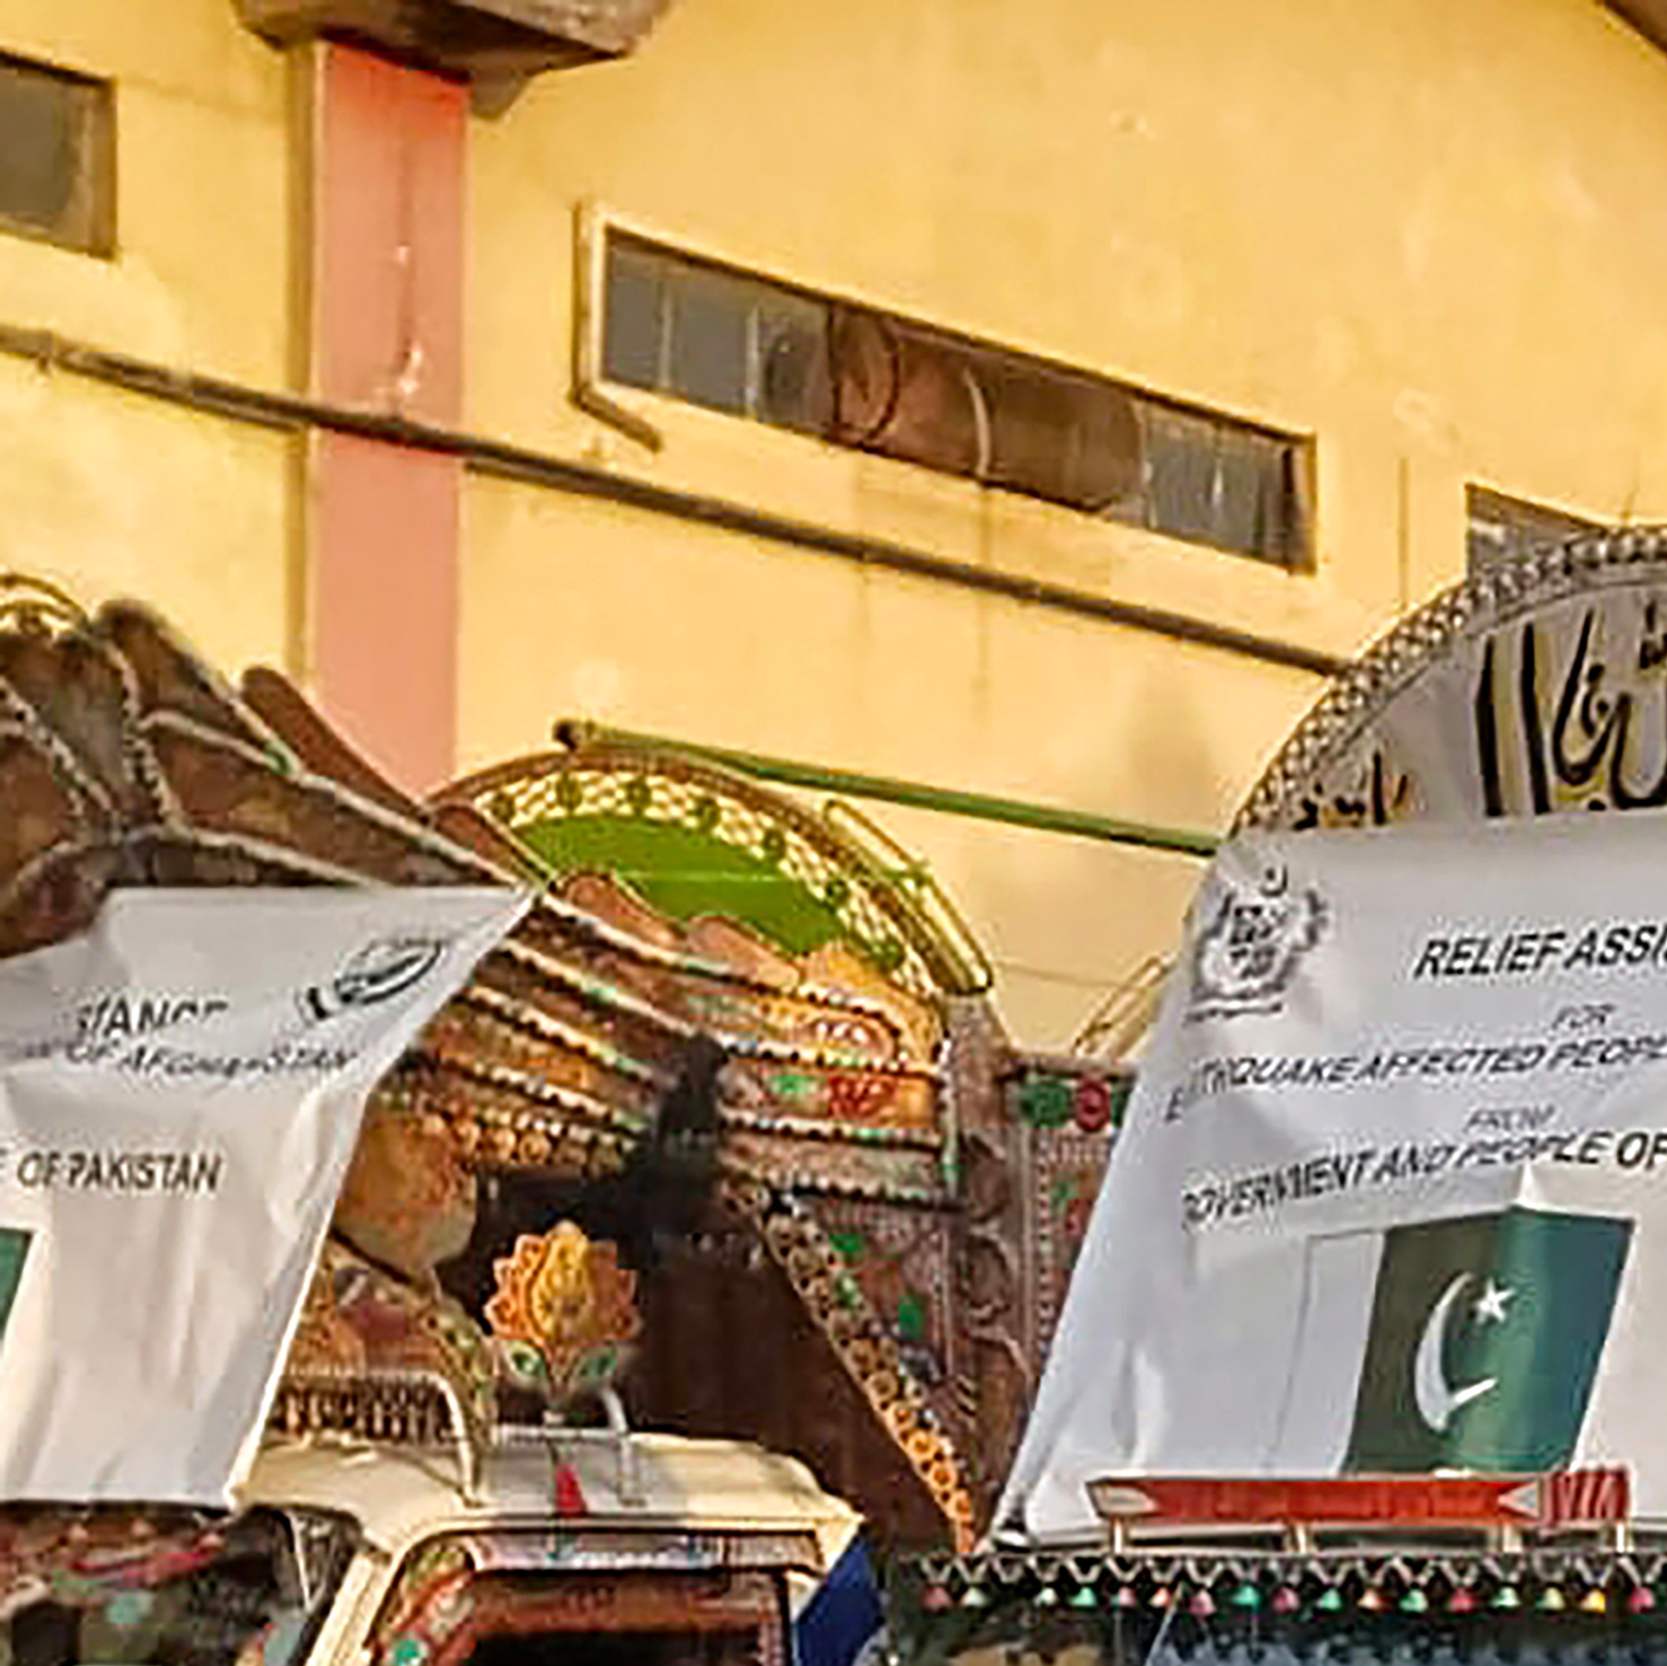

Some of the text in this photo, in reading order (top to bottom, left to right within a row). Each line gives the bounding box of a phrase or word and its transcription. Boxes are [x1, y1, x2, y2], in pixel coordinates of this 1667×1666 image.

[1413, 928, 1566, 980] RELIEF
[1550, 1002, 1616, 1031] FOR
[1354, 1042, 1547, 1082] AFFECTED
[17, 1149, 225, 1193] OF PAKISTAN
[1373, 1139, 1462, 1184] AND
[1456, 1131, 1606, 1170] PEOPLE
